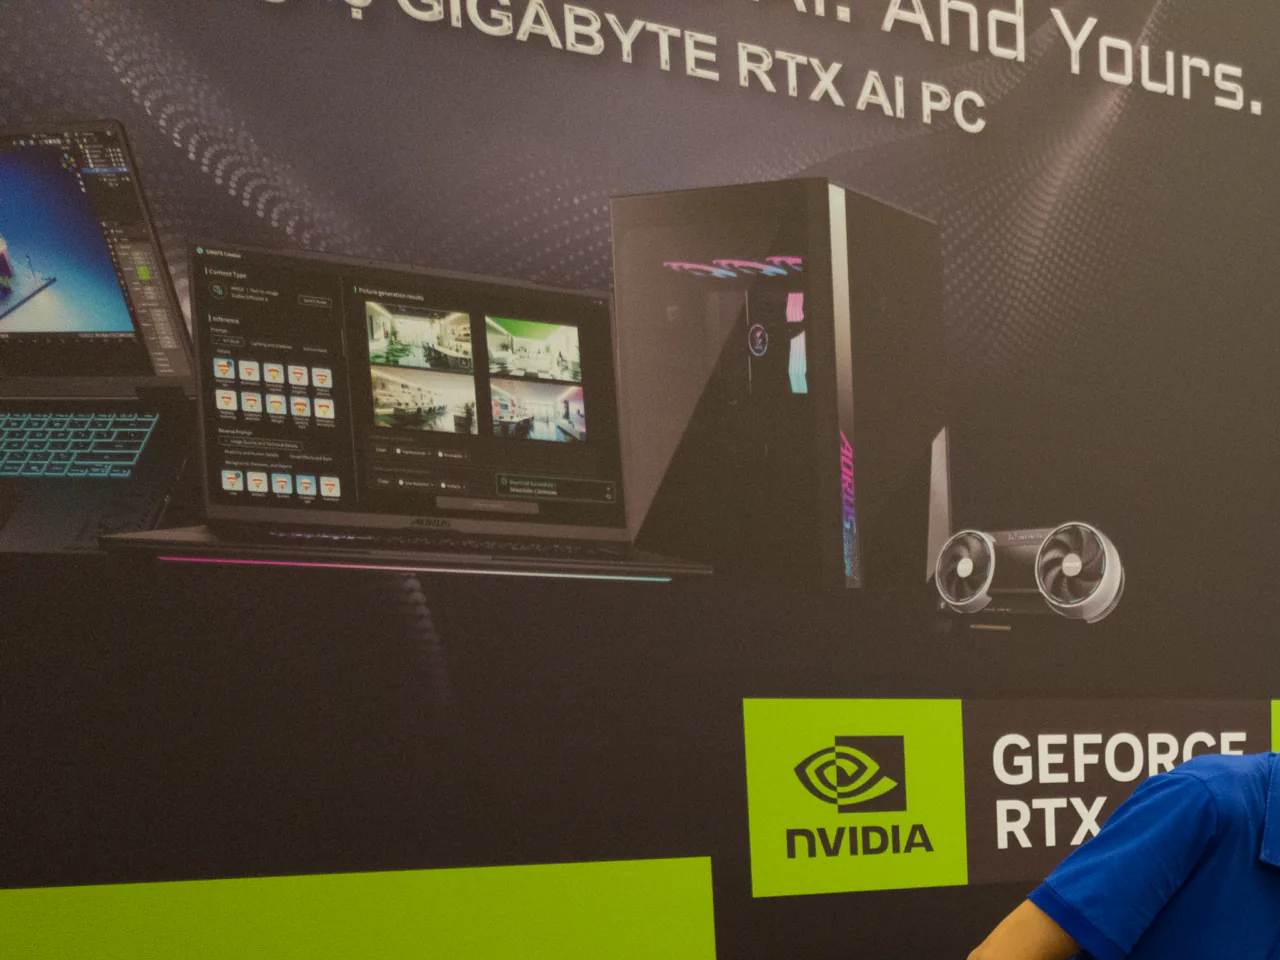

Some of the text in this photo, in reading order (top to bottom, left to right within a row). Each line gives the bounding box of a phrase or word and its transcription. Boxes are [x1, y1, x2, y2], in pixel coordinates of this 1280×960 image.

[738, 42, 845, 107] RTX
[856, 71, 904, 119] AI
[921, 82, 986, 134] PC
[881, 0, 1262, 116] And Yours.
[996, 796, 1108, 850] RTX
